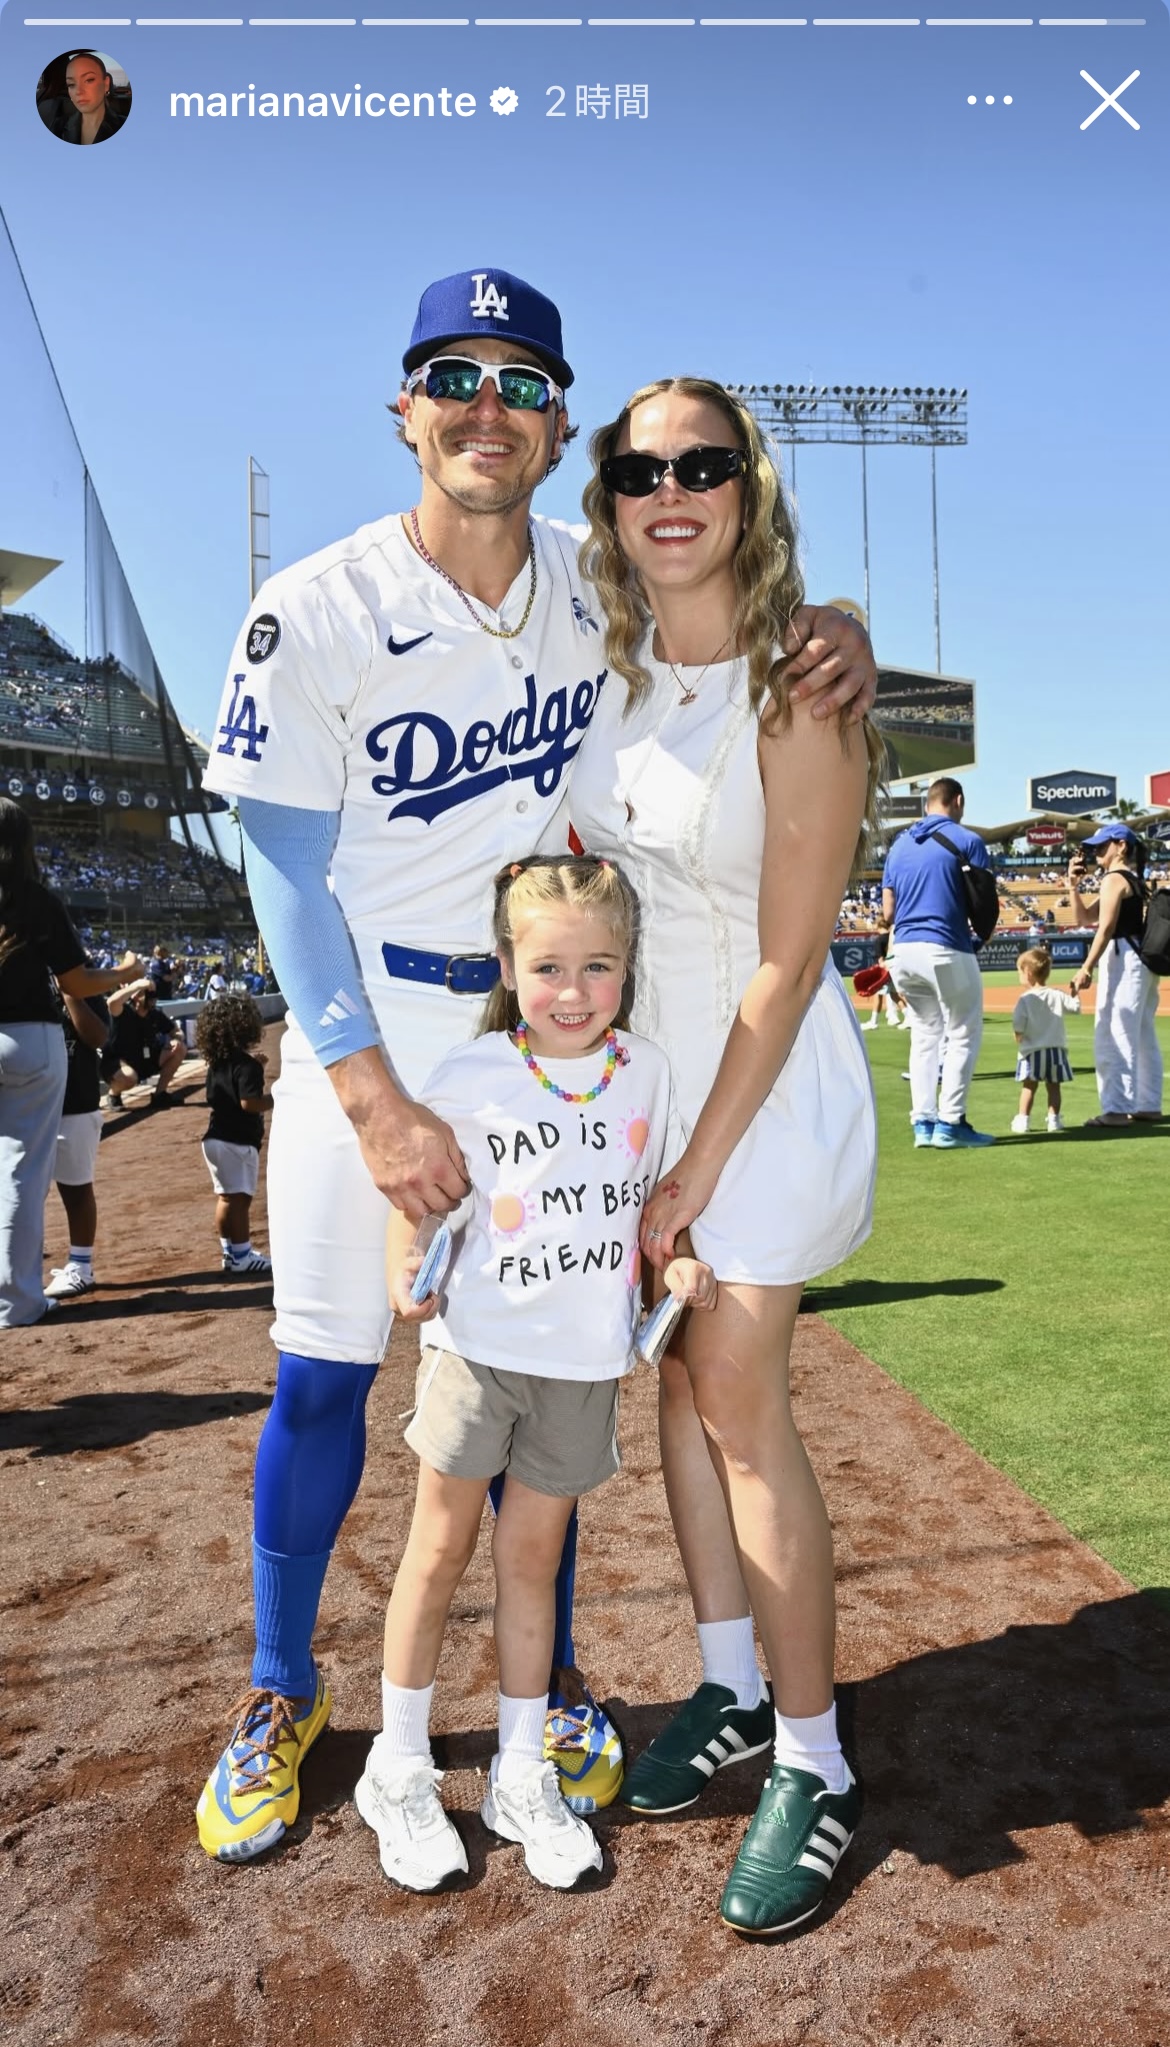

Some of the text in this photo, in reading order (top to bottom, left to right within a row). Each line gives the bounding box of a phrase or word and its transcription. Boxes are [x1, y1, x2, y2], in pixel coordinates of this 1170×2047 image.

[470, 273, 510, 320] LA
[249, 631, 272, 656] 34
[216, 673, 269, 762] LA
[366, 668, 608, 799] Dodger
[1036, 784, 1107, 802] Spectrum
[1028, 831, 1064, 840] Yakult
[1052, 945, 1079, 957] UCLA
[487, 1122, 560, 1165] DAD
[541, 1174, 650, 1217] MY BEST
